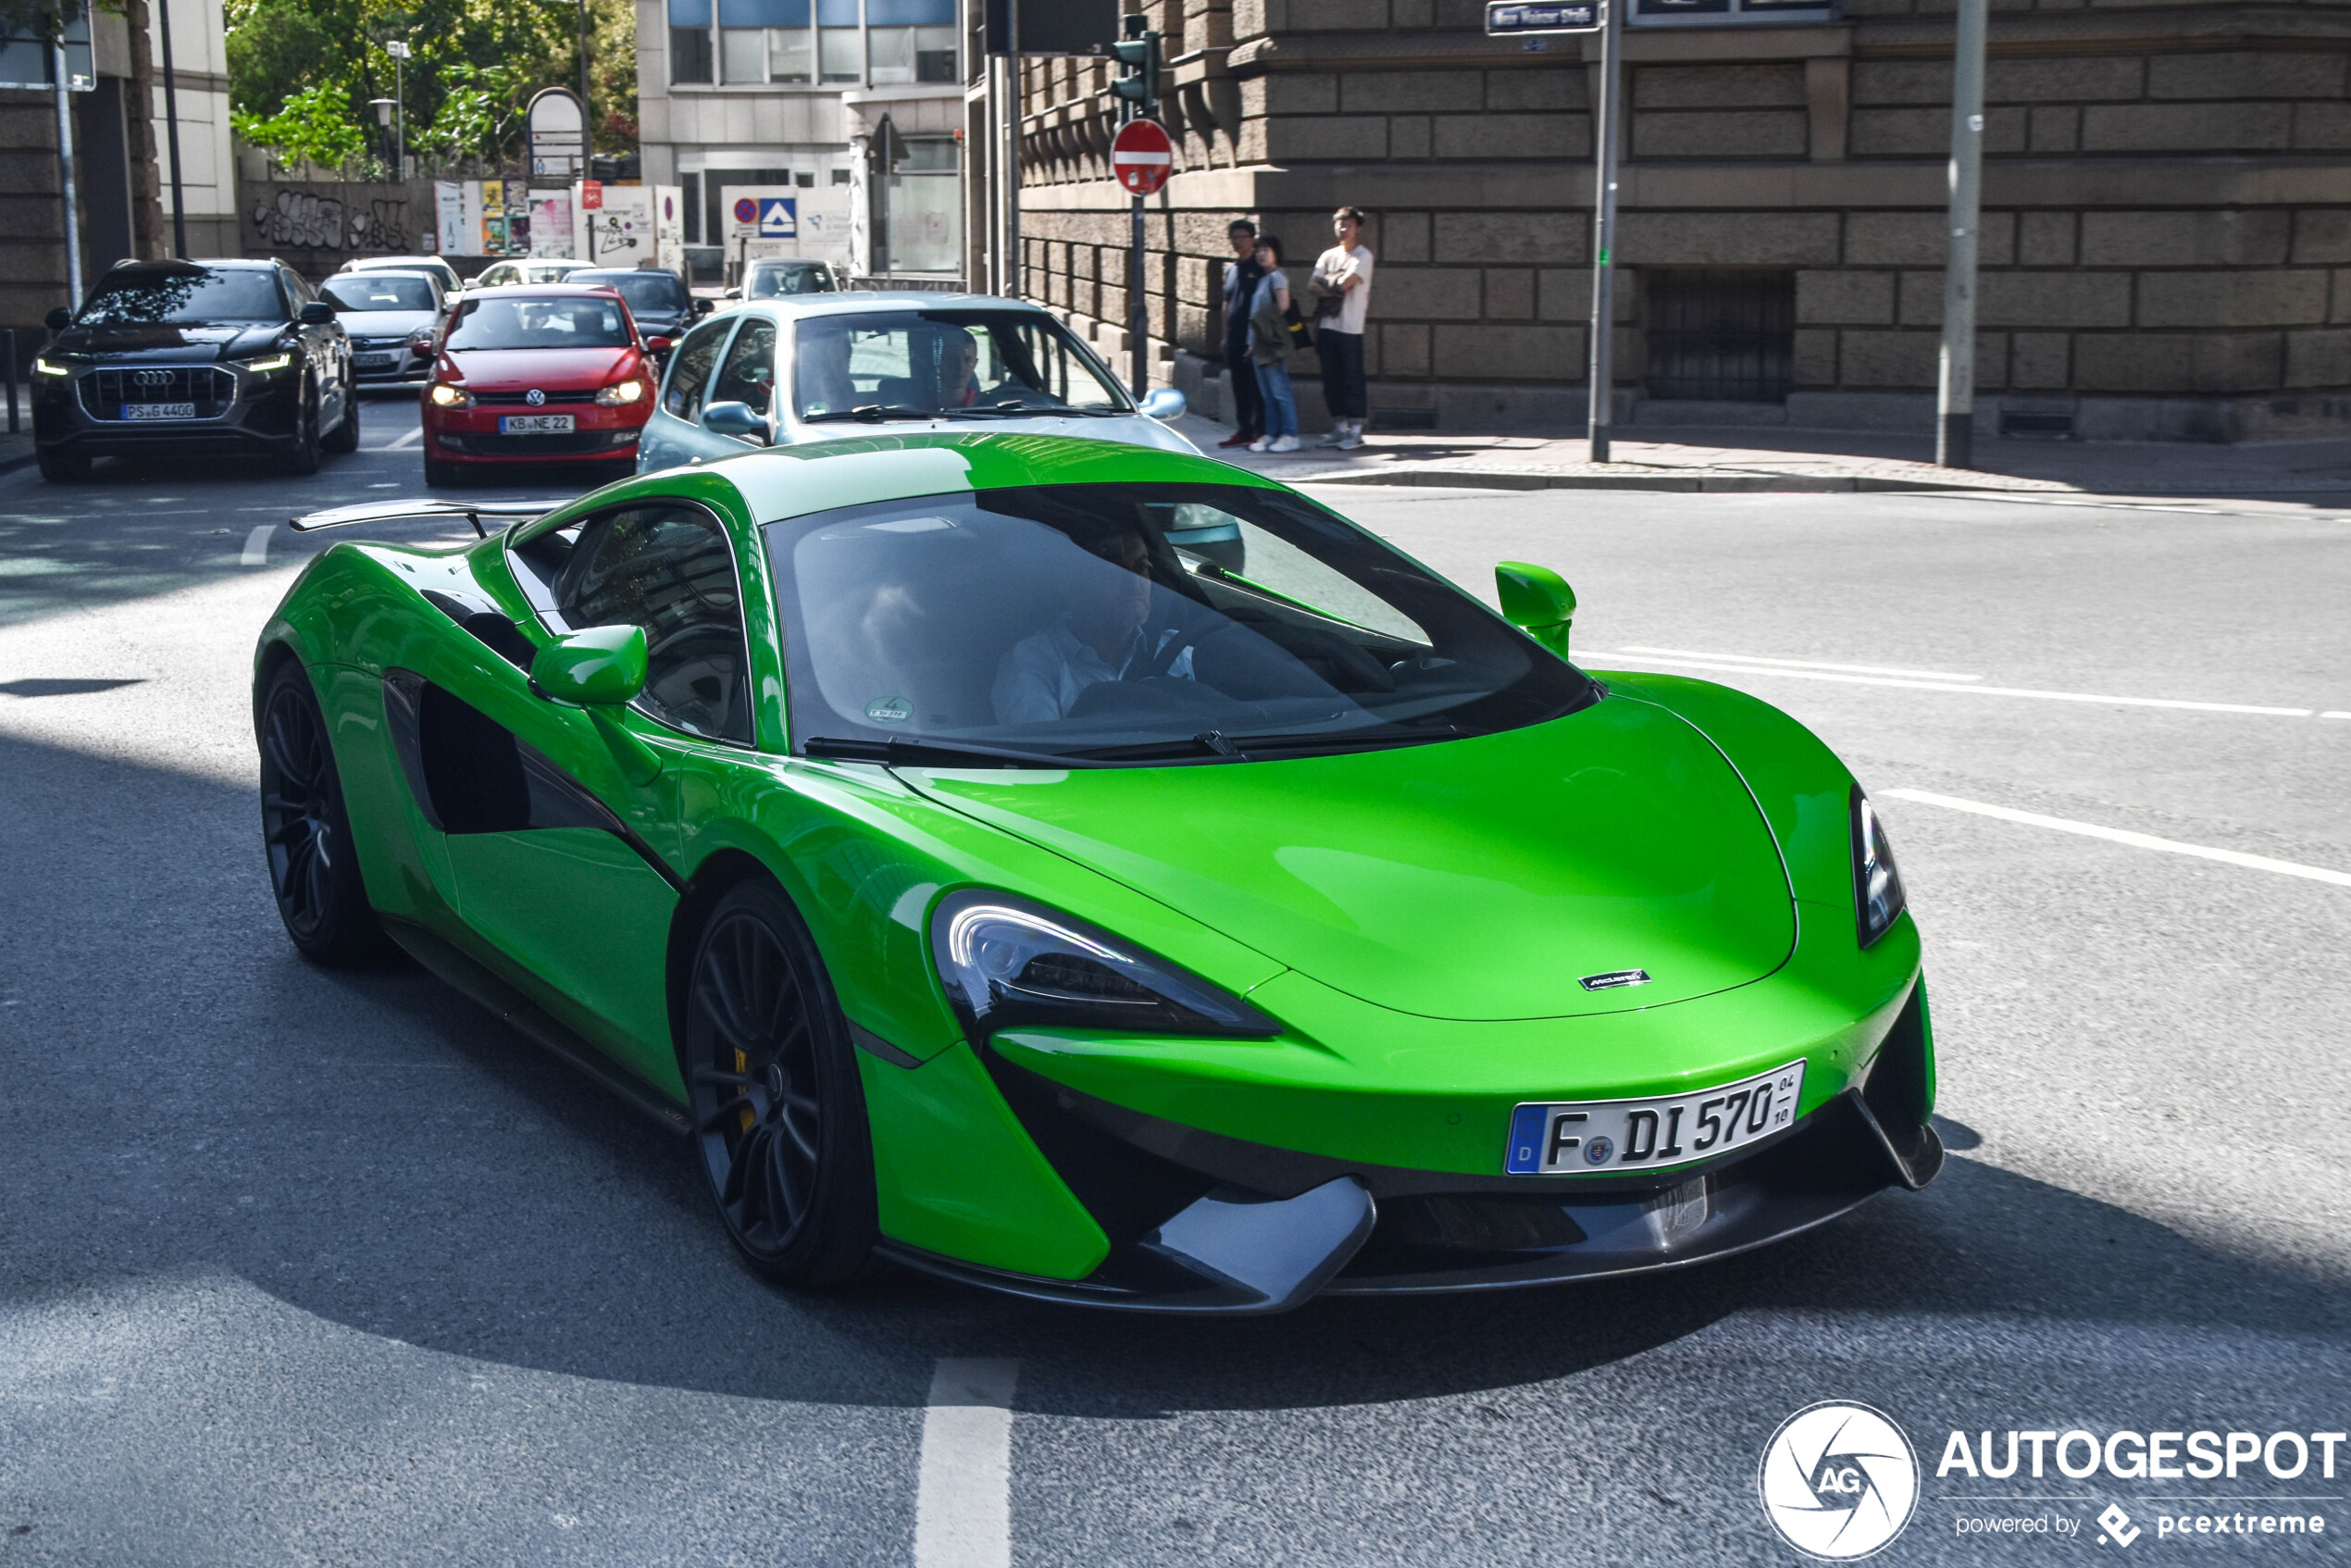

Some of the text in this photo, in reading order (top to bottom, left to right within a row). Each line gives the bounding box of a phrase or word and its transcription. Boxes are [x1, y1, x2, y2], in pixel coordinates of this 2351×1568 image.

[129, 404, 193, 417] PS G 4400
[508, 417, 568, 430] KB NE 22
[883, 697, 898, 710] 4
[1589, 974, 1642, 987] McLaren
[1780, 1074, 1795, 1092] 04
[1548, 1081, 1773, 1165] F DI 570
[1773, 1107, 1789, 1125] 10
[1518, 1147, 1532, 1162] D
